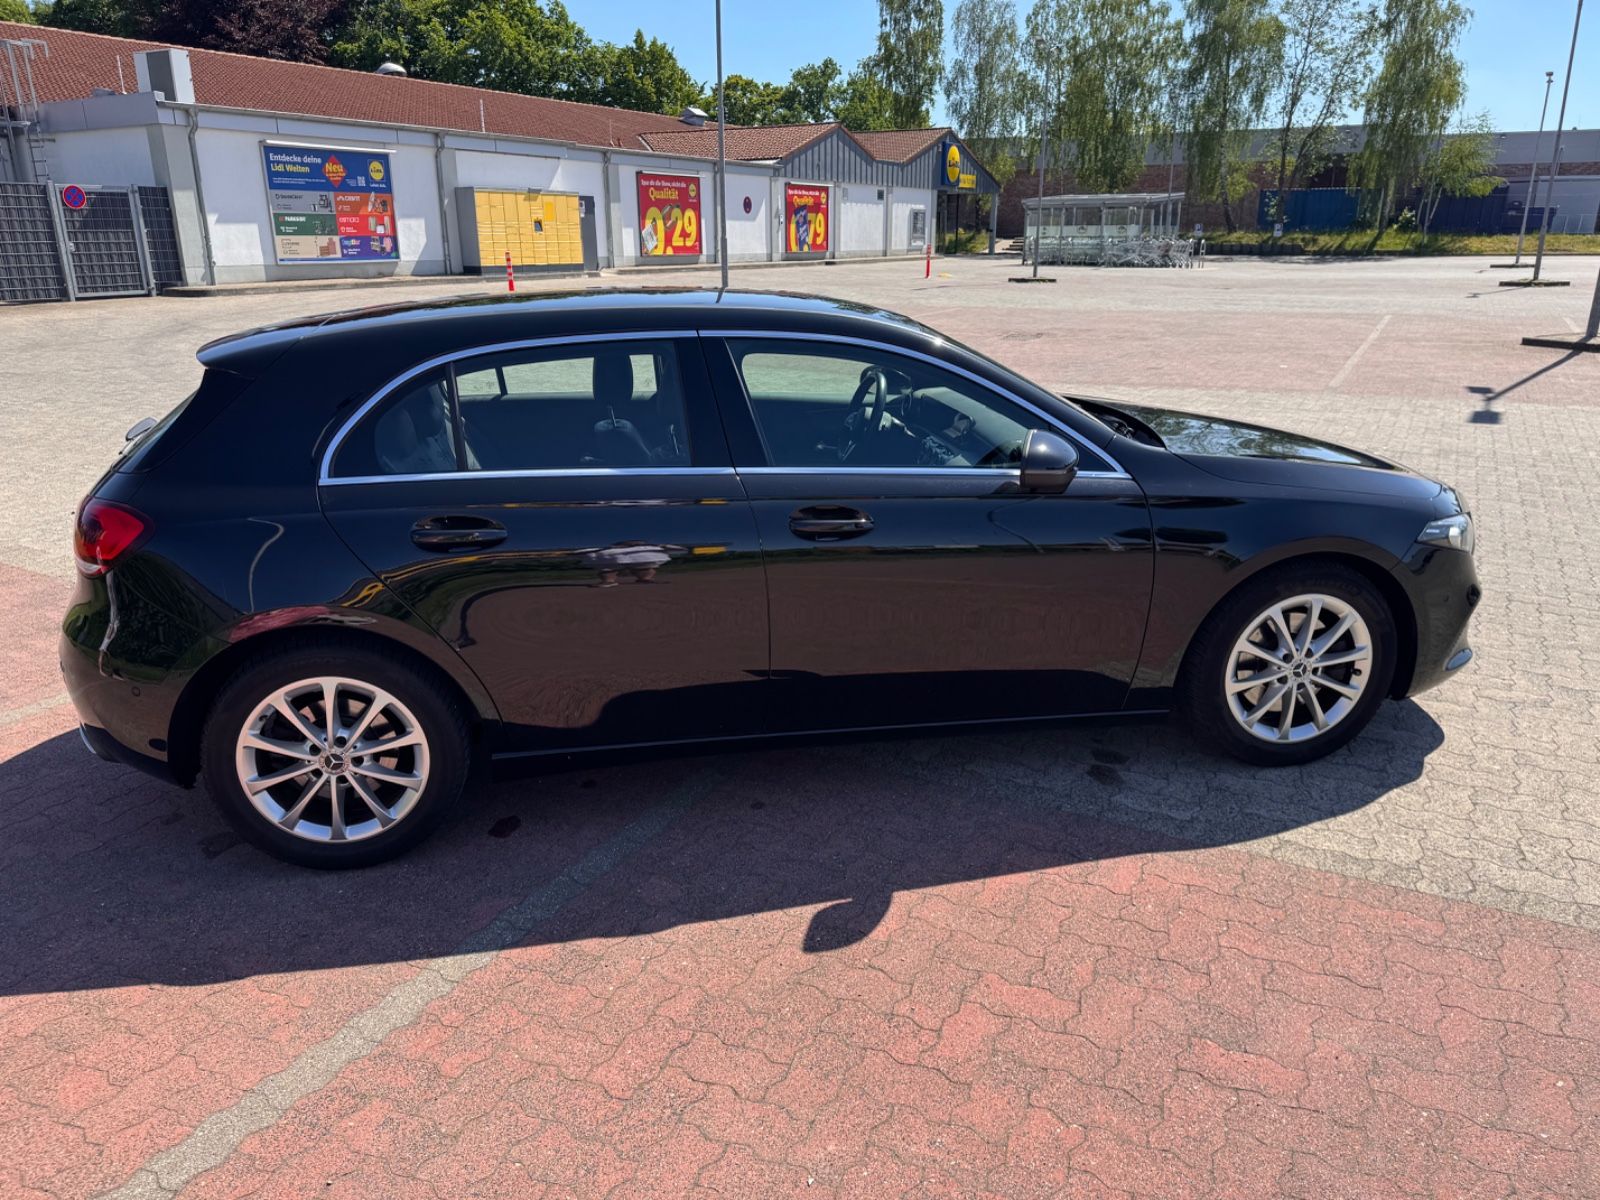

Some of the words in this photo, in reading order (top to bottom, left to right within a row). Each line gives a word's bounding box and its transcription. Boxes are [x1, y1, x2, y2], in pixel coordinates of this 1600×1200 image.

[269, 152, 301, 163] Entdecke
[303, 154, 322, 164] deine
[270, 163, 285, 172] Lidl
[285, 163, 310, 174] Welten
[325, 162, 344, 173] Neu
[648, 187, 679, 201] Qualität
